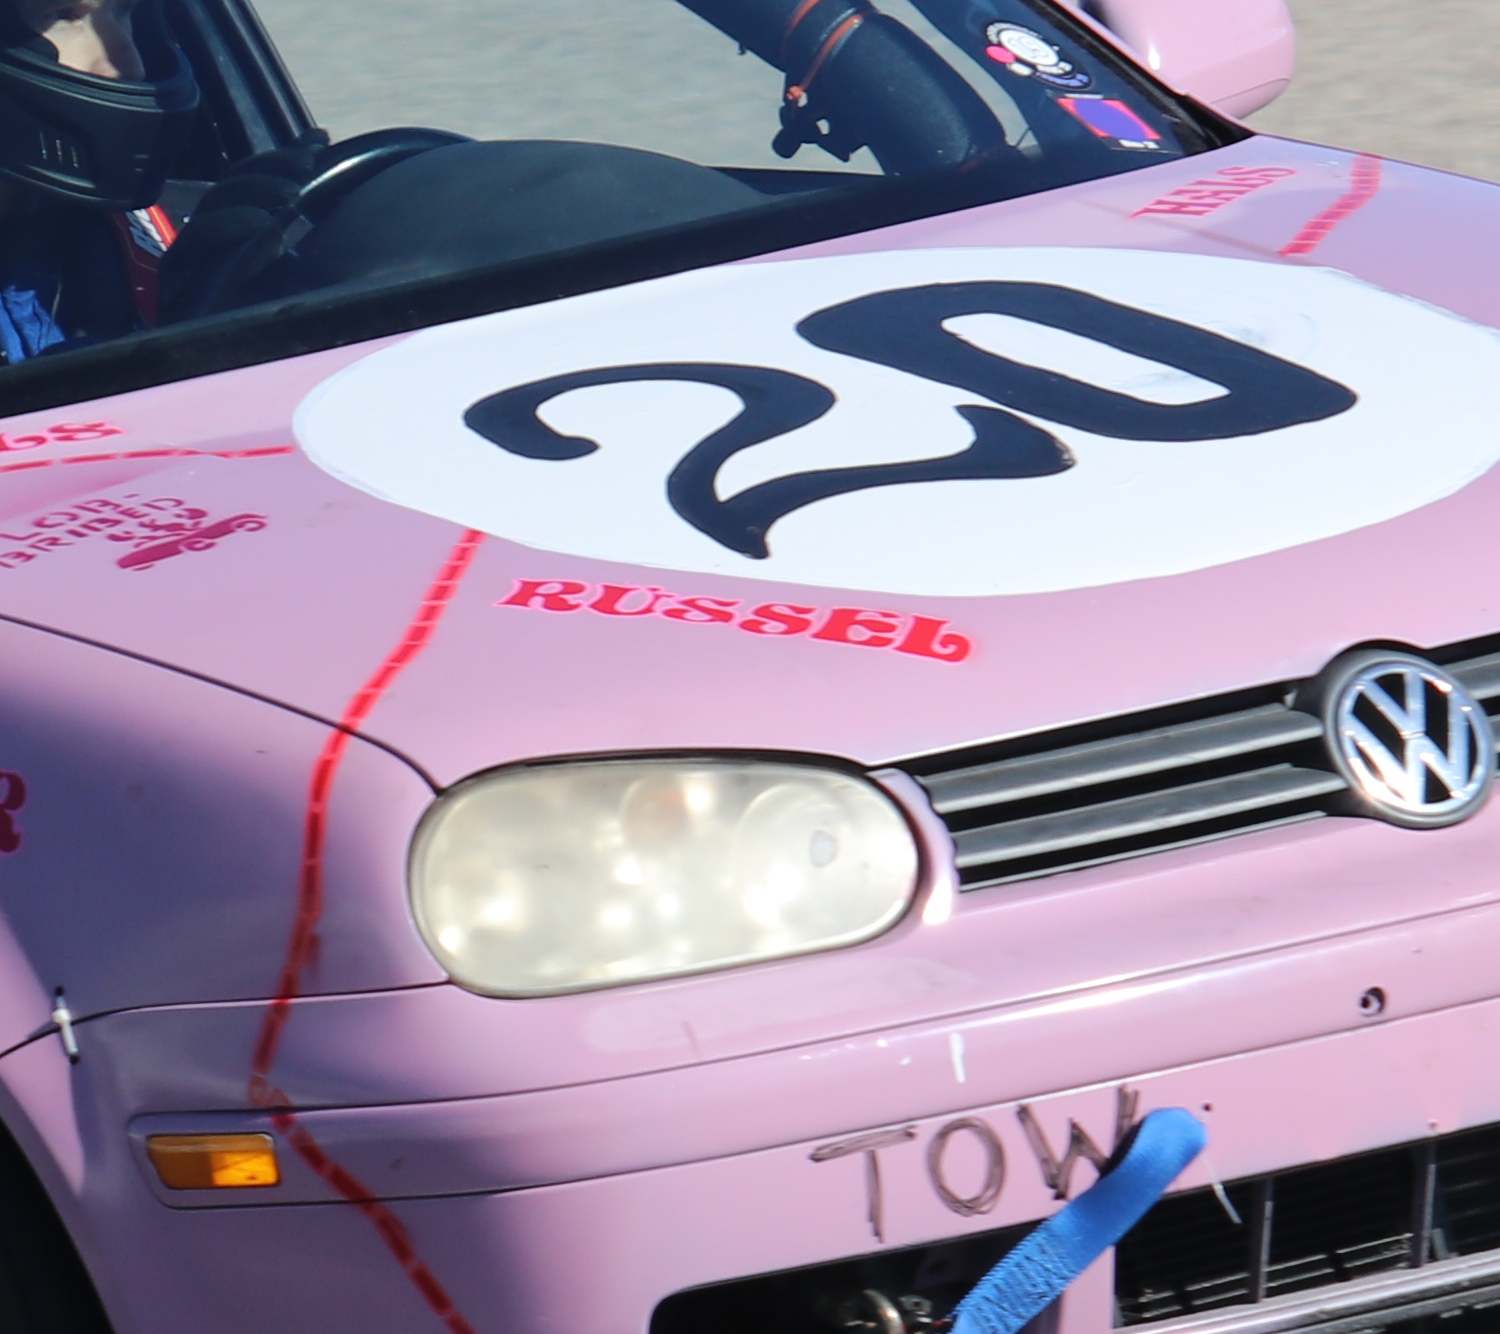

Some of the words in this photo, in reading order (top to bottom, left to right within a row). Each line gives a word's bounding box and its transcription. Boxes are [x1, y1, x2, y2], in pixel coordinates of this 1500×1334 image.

[1126, 165, 1298, 219] HALS
[463, 280, 1358, 559] 20
[807, 1083, 1142, 1244] TOW
